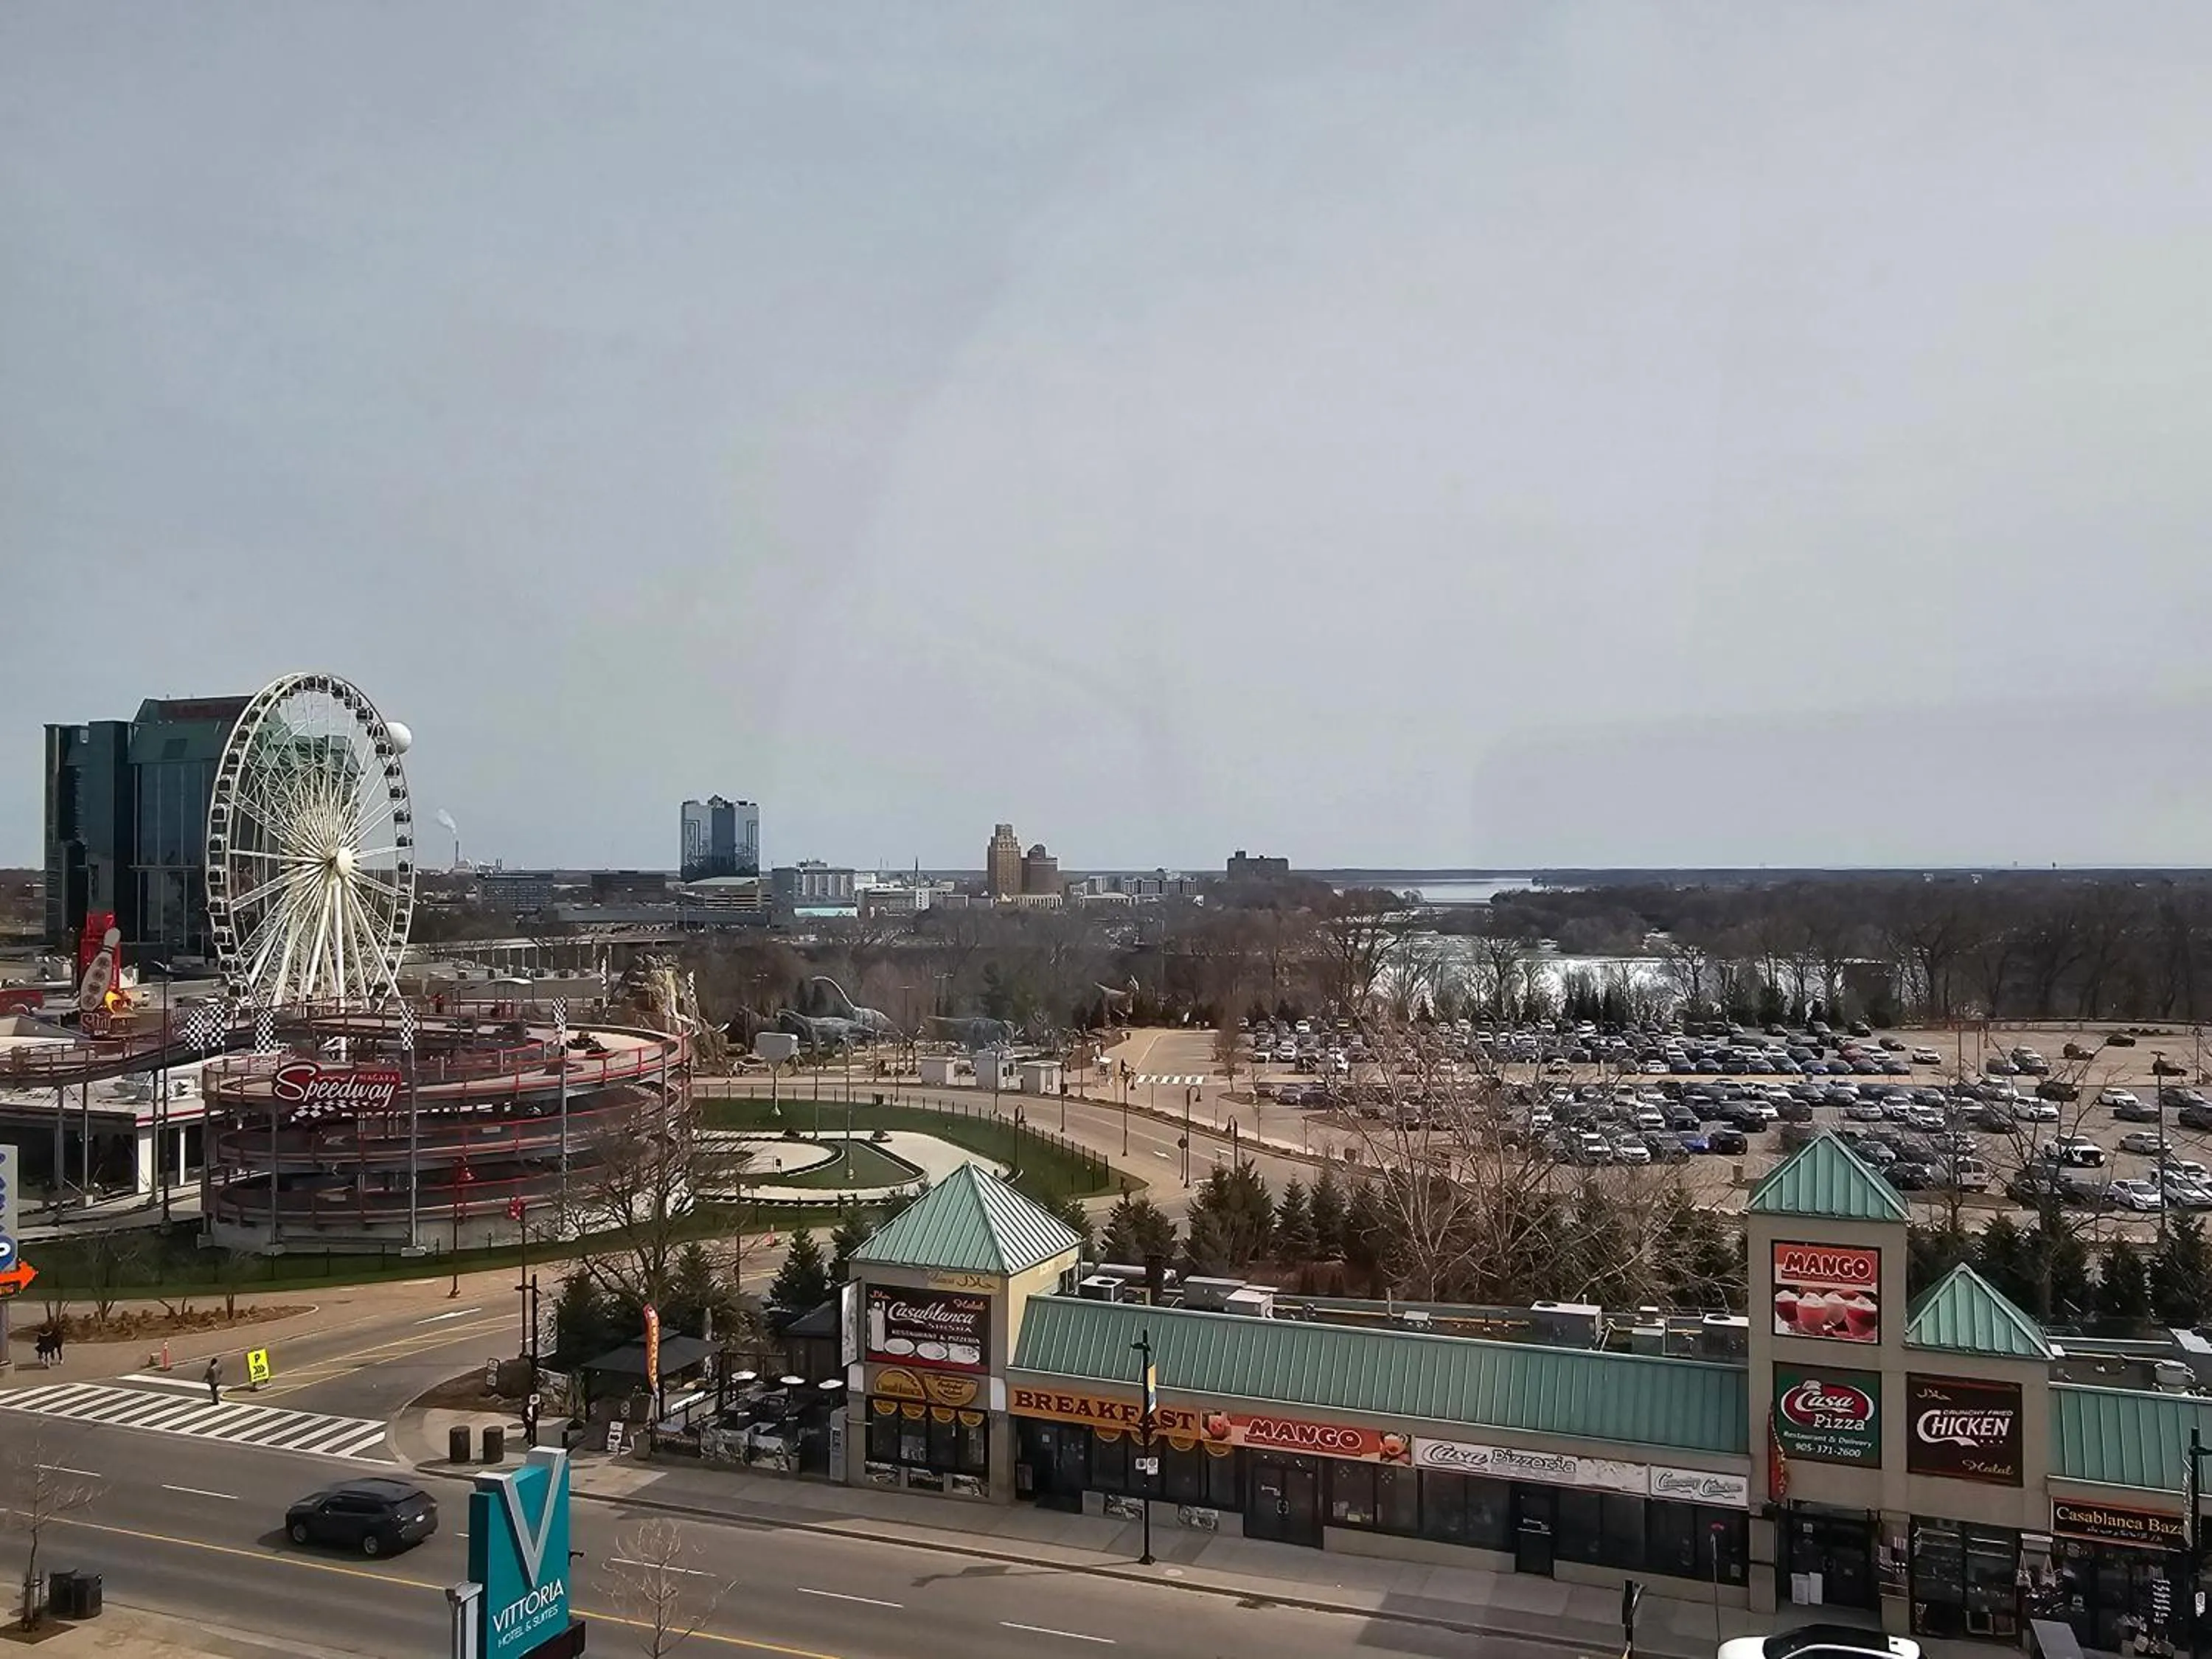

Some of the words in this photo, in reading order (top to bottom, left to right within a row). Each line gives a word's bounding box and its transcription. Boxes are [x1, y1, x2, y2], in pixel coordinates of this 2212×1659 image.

[274, 1065, 395, 1108] Speedway
[358, 1074, 397, 1082] NIAGARA
[1783, 1251, 1871, 1279] MANGO
[888, 1301, 977, 1325] Casablanca
[1015, 1389, 1195, 1431] BREAKFAST
[1794, 1390, 1855, 1413] Casa
[1248, 1419, 1363, 1450] MANGO
[1814, 1413, 1865, 1431] Pizza
[1917, 1409, 2011, 1448] CHICKEN
[1422, 1442, 1489, 1472] Casa
[1490, 1449, 1577, 1474] Pizzeria
[490, 1446, 568, 1587] V
[2056, 1506, 2144, 1531] Casablanca
[493, 1578, 564, 1633] VITTORIA
[498, 1627, 524, 1649] HOTEL
[526, 1621, 532, 1632] &
[532, 1604, 558, 1628] SUITES
